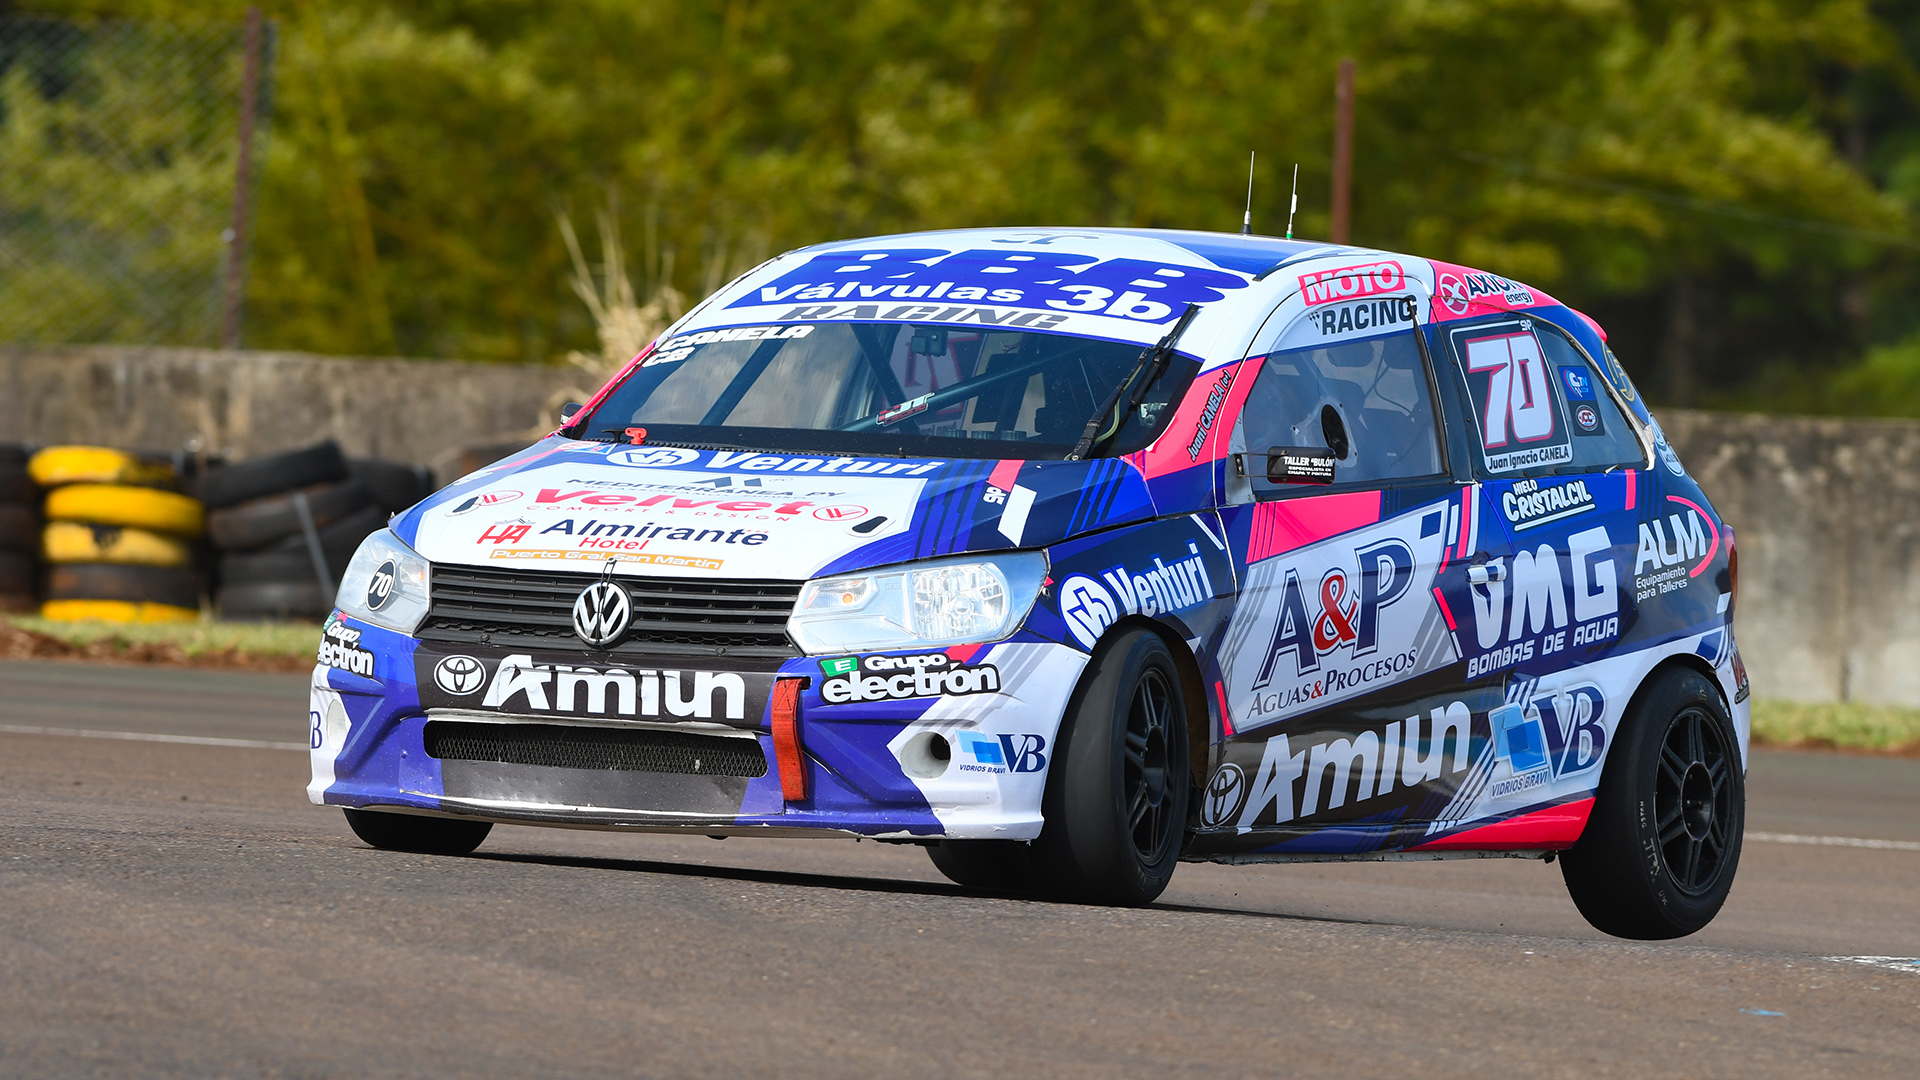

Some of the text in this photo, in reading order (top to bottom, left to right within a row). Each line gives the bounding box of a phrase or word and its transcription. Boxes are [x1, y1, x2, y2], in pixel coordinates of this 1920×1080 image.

[1304, 263, 1402, 303] MOTO
[761, 281, 1172, 320] Válvulas 3b
[1505, 291, 1533, 304] energy
[777, 304, 1069, 329] RACING
[1322, 300, 1418, 336] RACING
[657, 325, 815, 351] CANELA
[1465, 331, 1554, 449] 70
[1187, 422, 1208, 462] Juani
[1200, 383, 1226, 430] CANELA
[705, 451, 945, 476] Venturi
[1283, 456, 1310, 466] TALLER
[1489, 446, 1570, 470] Juan Ignacio CANELA
[1502, 480, 1593, 522] CRISTALCIL
[1512, 479, 1538, 496] HIELO
[527, 505, 654, 513] COMFORT
[694, 511, 790, 522] DESIGN
[535, 488, 816, 515] Velvet
[539, 518, 769, 546] Almirante
[578, 536, 650, 550] Hotel
[1634, 509, 1707, 576] ALM
[492, 550, 561, 559] Puerto
[612, 553, 651, 563] San
[654, 555, 720, 569] Martin
[368, 572, 393, 598] 70
[1103, 542, 1214, 618] Venturi
[1636, 566, 1686, 589] Equipamiento
[1637, 578, 1688, 604] para Talleres
[1250, 537, 1417, 692] A&P
[326, 620, 361, 643] Grupo
[1467, 616, 1619, 679] BOMBAS DE AGUA
[864, 655, 948, 671] Grupo
[481, 654, 745, 720] Amiun
[822, 662, 998, 703] electrón
[1531, 685, 1606, 780] VB
[995, 733, 1047, 774] VB
[959, 764, 1006, 775] VIDRIOS BRAVI
[1237, 700, 1471, 836] Amiun
[1491, 770, 1548, 797] VIDRIOS BRAVI
